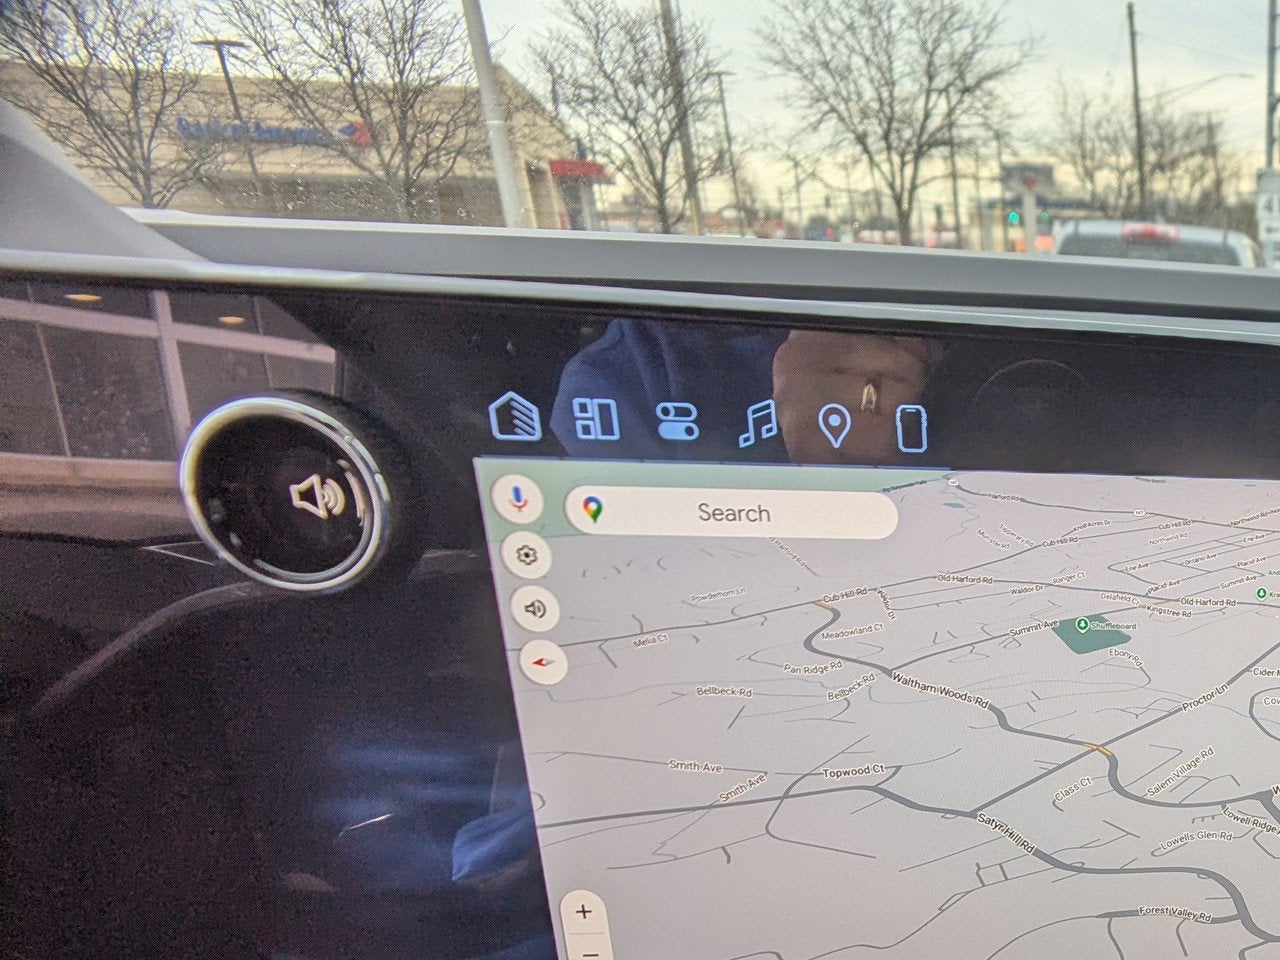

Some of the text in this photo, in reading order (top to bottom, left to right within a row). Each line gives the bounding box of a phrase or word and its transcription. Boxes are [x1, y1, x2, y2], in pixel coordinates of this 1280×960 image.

[698, 503, 771, 523] Search
[1056, 538, 1068, 546] Hill
[937, 574, 993, 584] Old Harford Rd
[1220, 574, 1257, 589] Summit Ave
[839, 591, 853, 601] Hill
[855, 587, 868, 595] Rd
[1180, 598, 1236, 607] Old Harford Rd
[1147, 605, 1192, 618] Kingstree Rd
[1009, 619, 1059, 637] Summit Ave
[1091, 622, 1137, 631] Shuffleboard
[1109, 648, 1143, 667] Ebony Rd
[784, 660, 842, 675] Pan Ridge Rd
[1253, 668, 1274, 676] Cider
[697, 686, 752, 697] Bellbeck Rd
[827, 673, 875, 700] Bellbeck Rd
[892, 672, 989, 709] Waltham Woods Rd
[1182, 684, 1228, 712] Proctor Ln
[668, 760, 723, 773] Smith Ave
[823, 764, 885, 779] Topwood Ct
[1147, 747, 1214, 797] Salem Village Rd
[719, 774, 766, 803] Smith Ave
[1054, 777, 1092, 802] Class Ct
[1223, 806, 1251, 825] Lowell
[1252, 819, 1277, 833] Ridge
[978, 813, 1034, 853] Satyr Hill Rd
[1160, 831, 1232, 849] Lowells Glen Rd
[1139, 906, 1211, 922] Forest Valley Rd
